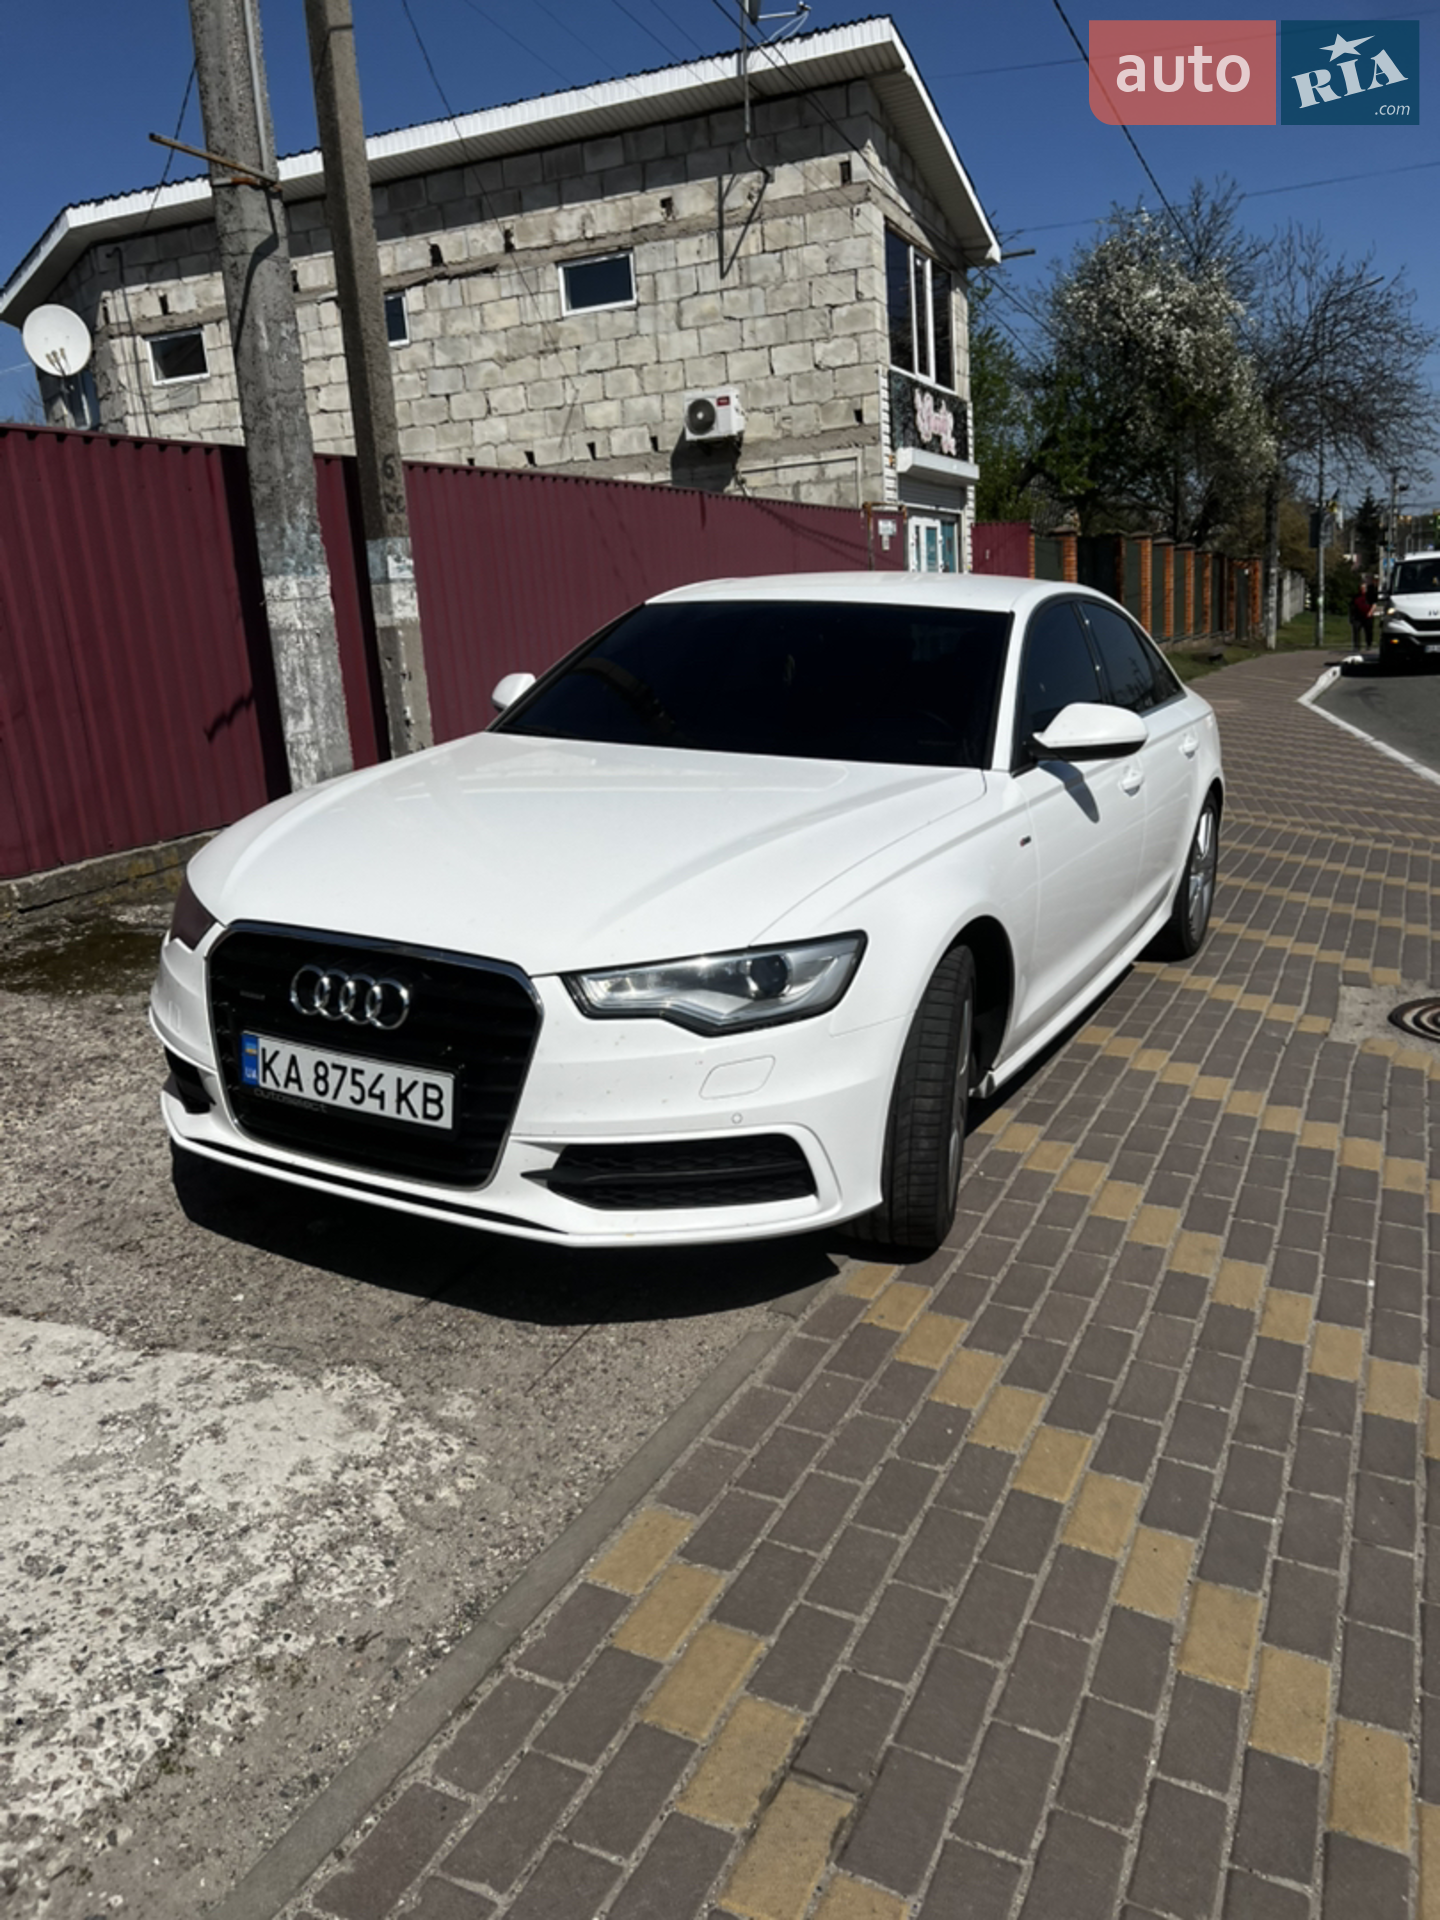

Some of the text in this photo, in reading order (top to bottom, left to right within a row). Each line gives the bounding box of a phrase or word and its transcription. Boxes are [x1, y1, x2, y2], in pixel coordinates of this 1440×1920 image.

[261, 1047, 445, 1123] KA 8754 KB
